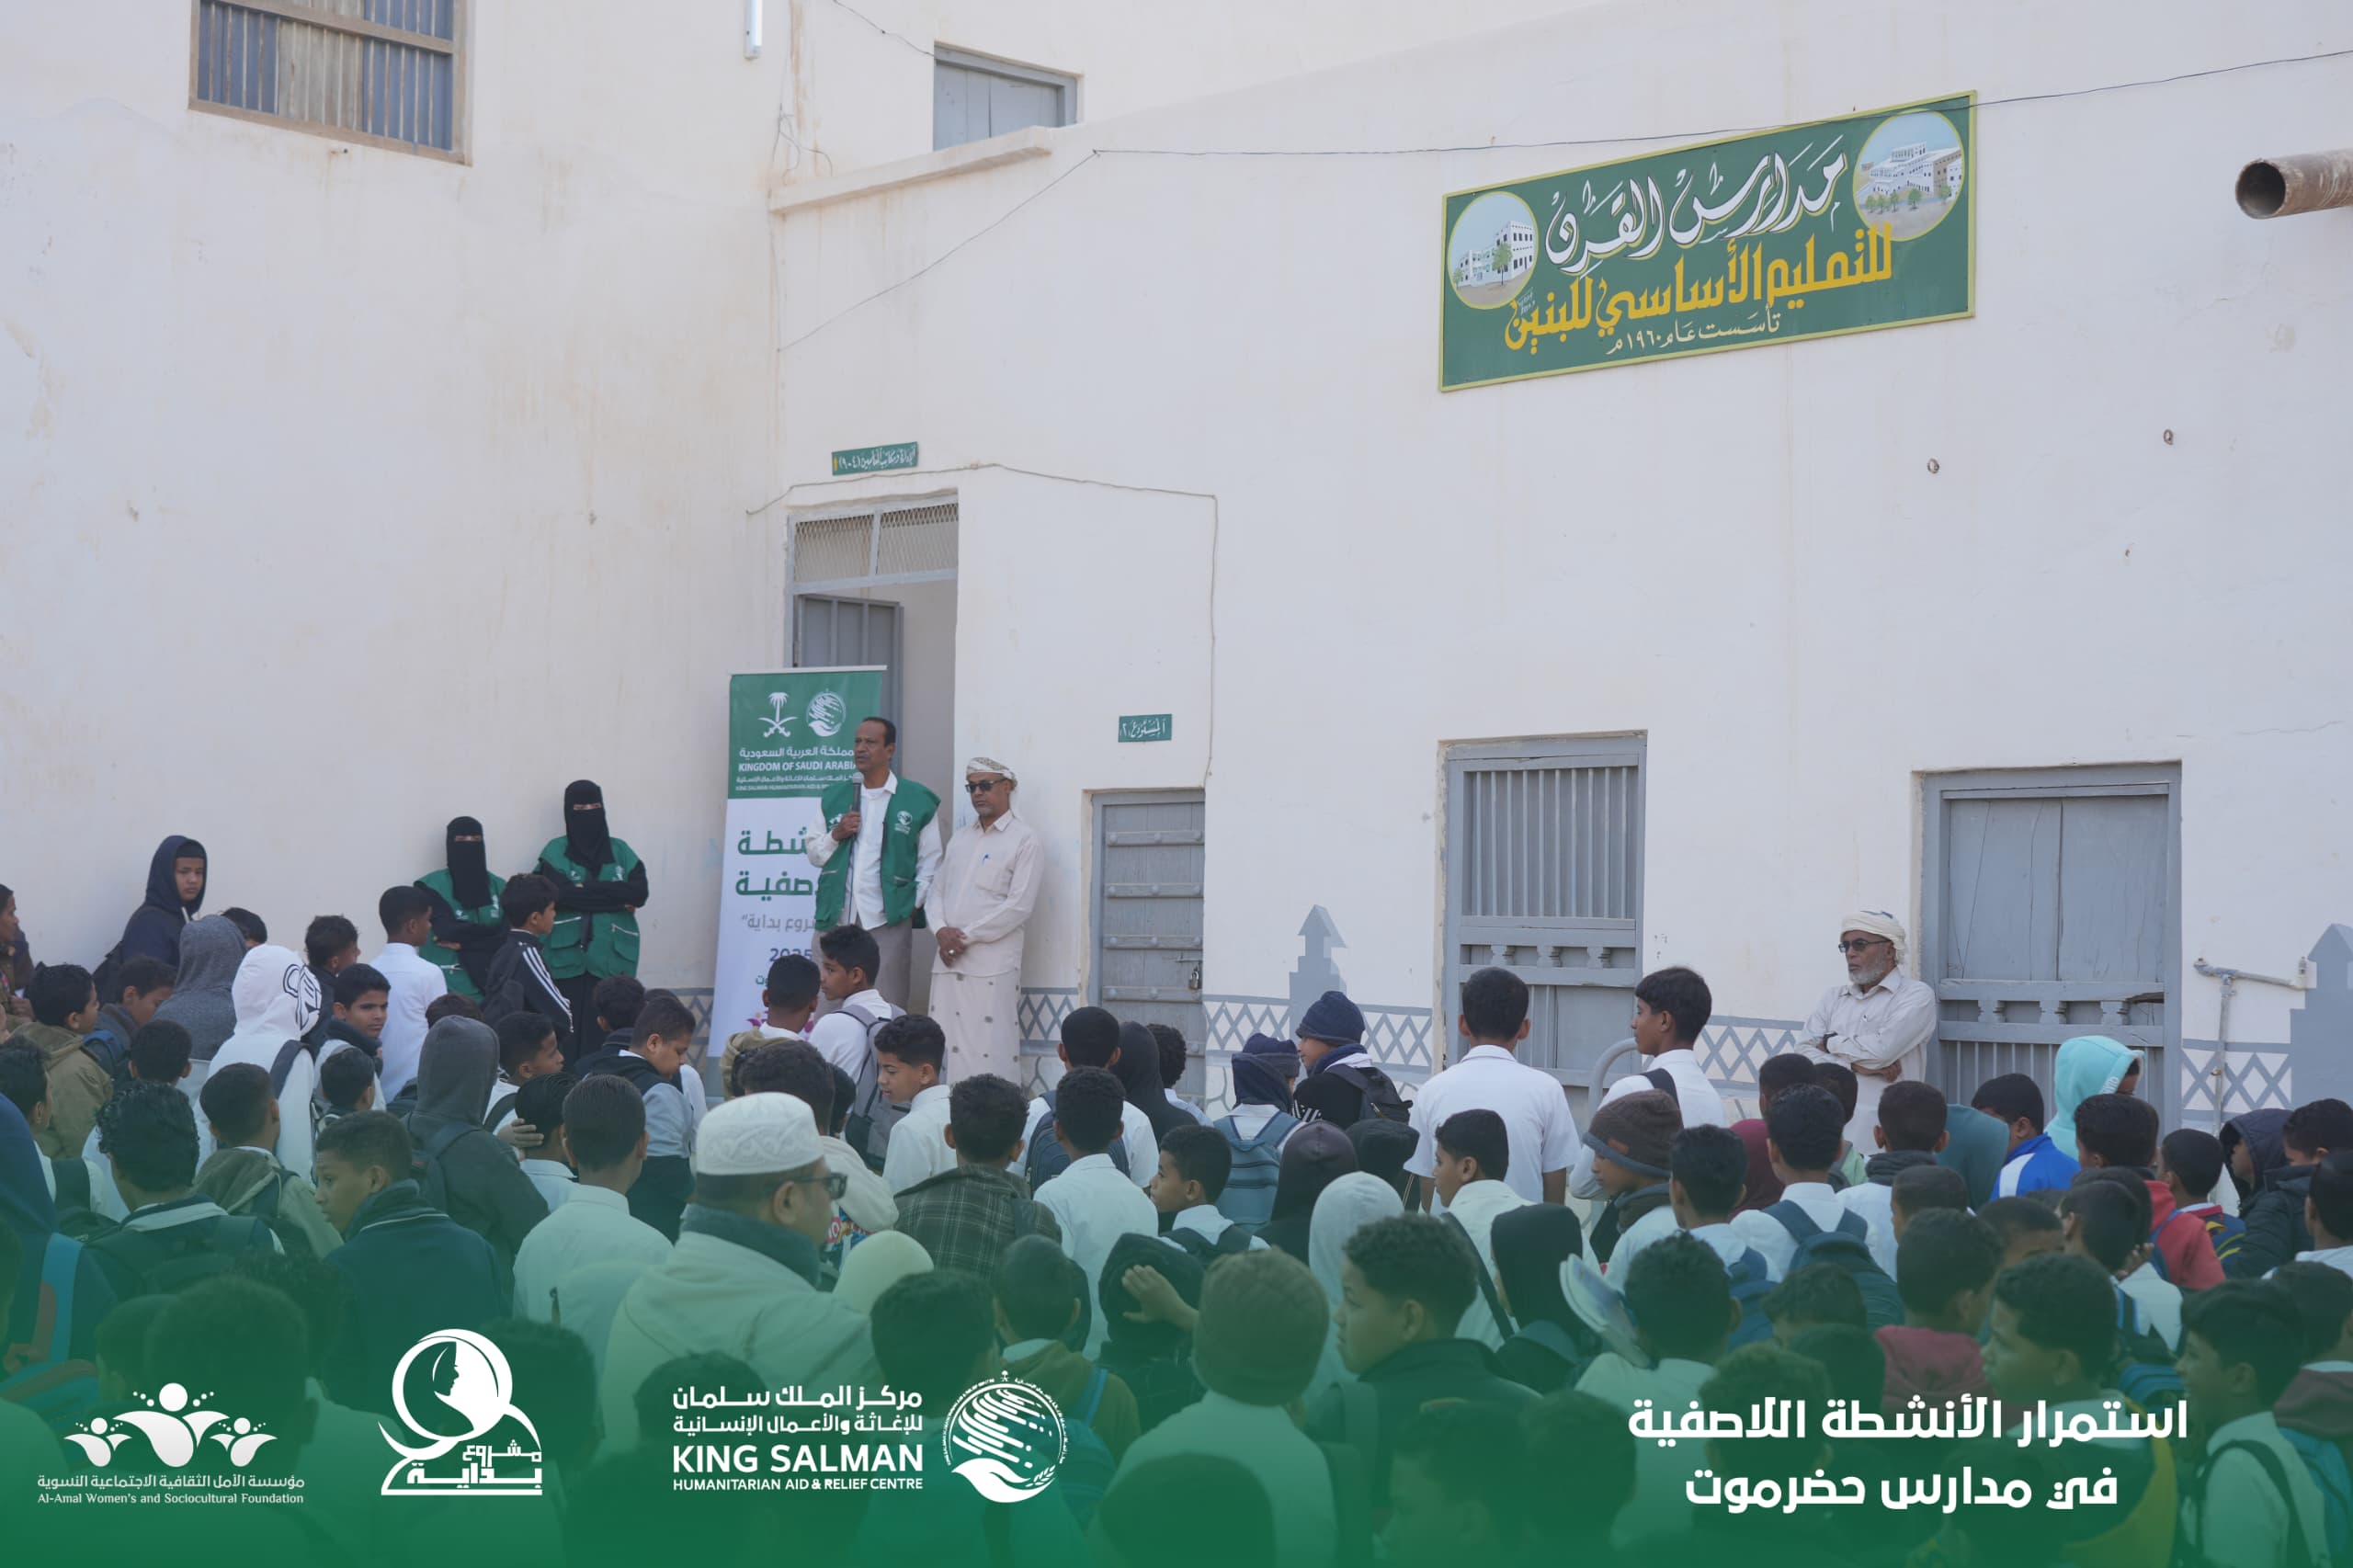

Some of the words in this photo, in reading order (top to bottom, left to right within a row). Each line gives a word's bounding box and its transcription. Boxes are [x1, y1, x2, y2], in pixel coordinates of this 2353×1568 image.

[1669, 136, 1847, 249] مدارس
[1545, 176, 1665, 277] القرن
[1766, 222, 1892, 309] للتعليم
[1596, 238, 1762, 338] الأساسي
[1504, 276, 1594, 355] للبنين
[739, 747, 785, 760] السعودية
[786, 746, 818, 759] العربية
[820, 745, 854, 756] مملكة
[738, 762, 780, 772] KINGDOM
[782, 762, 794, 771] OF
[795, 761, 823, 771] SAUDI
[735, 871, 813, 902] صفية
[784, 918, 815, 933] روع
